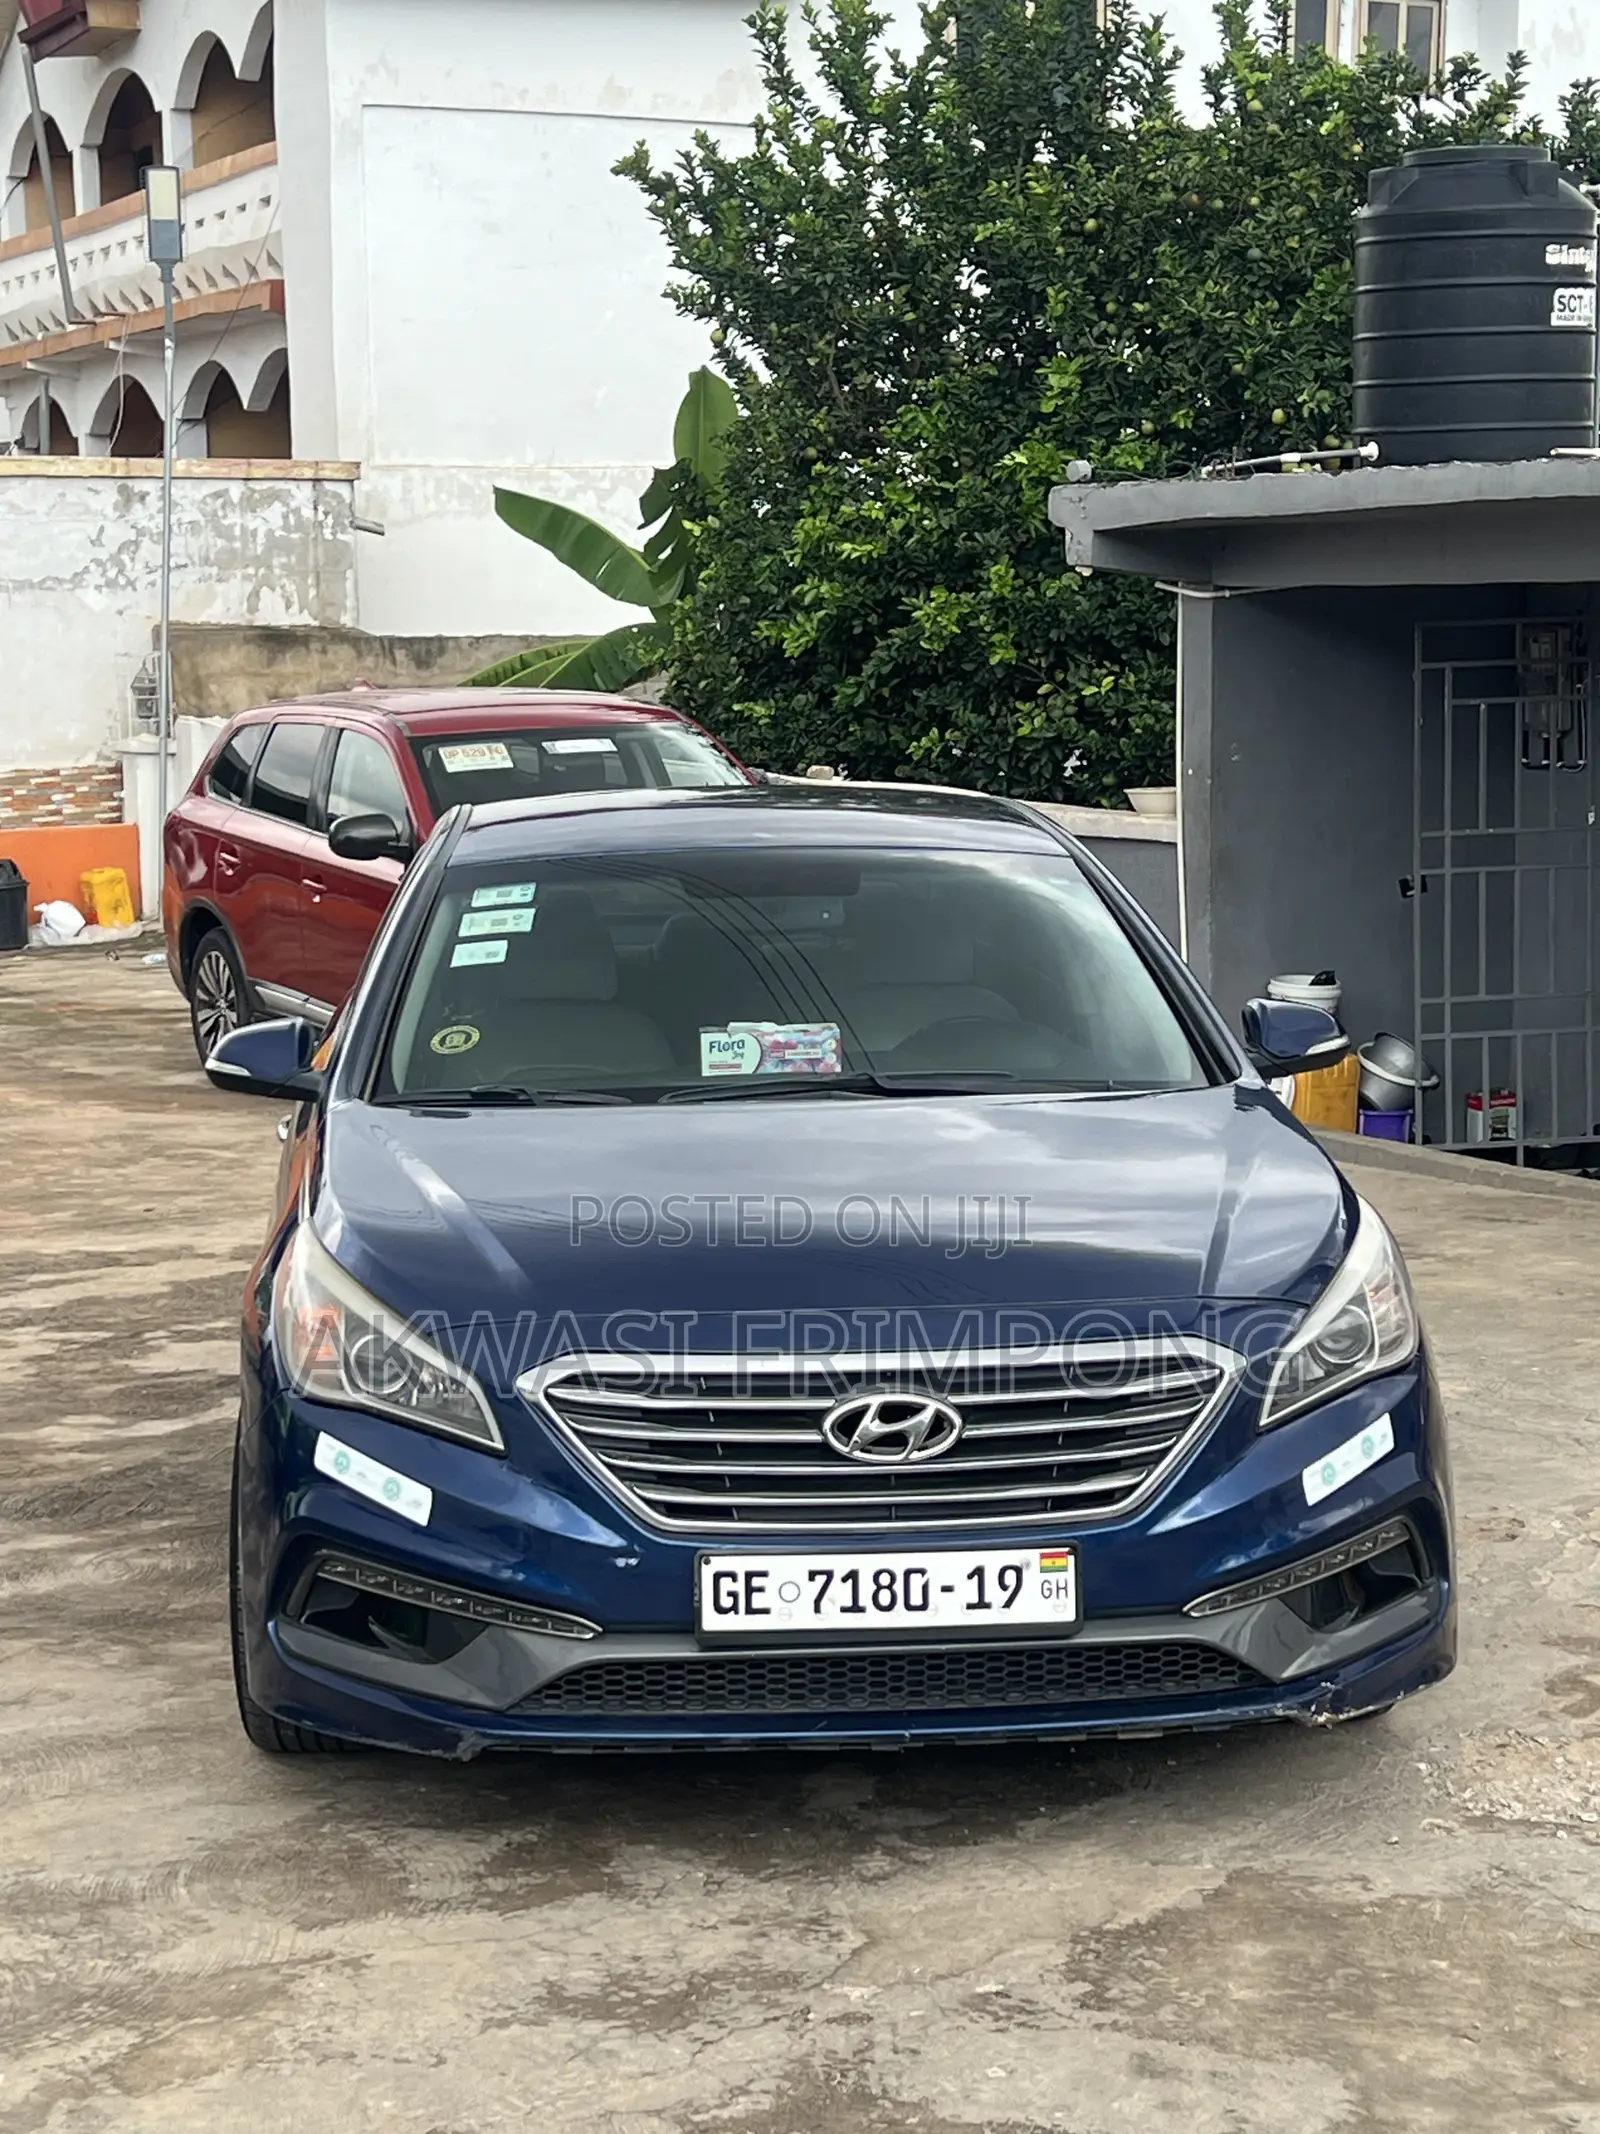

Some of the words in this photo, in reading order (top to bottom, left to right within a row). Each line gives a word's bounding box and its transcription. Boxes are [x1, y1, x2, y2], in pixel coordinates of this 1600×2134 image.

[709, 1039, 745, 1054] Flora
[712, 1569, 771, 1616] GE
[807, 1564, 1024, 1615] 7180-19
[1040, 1578, 1069, 1600] GH
